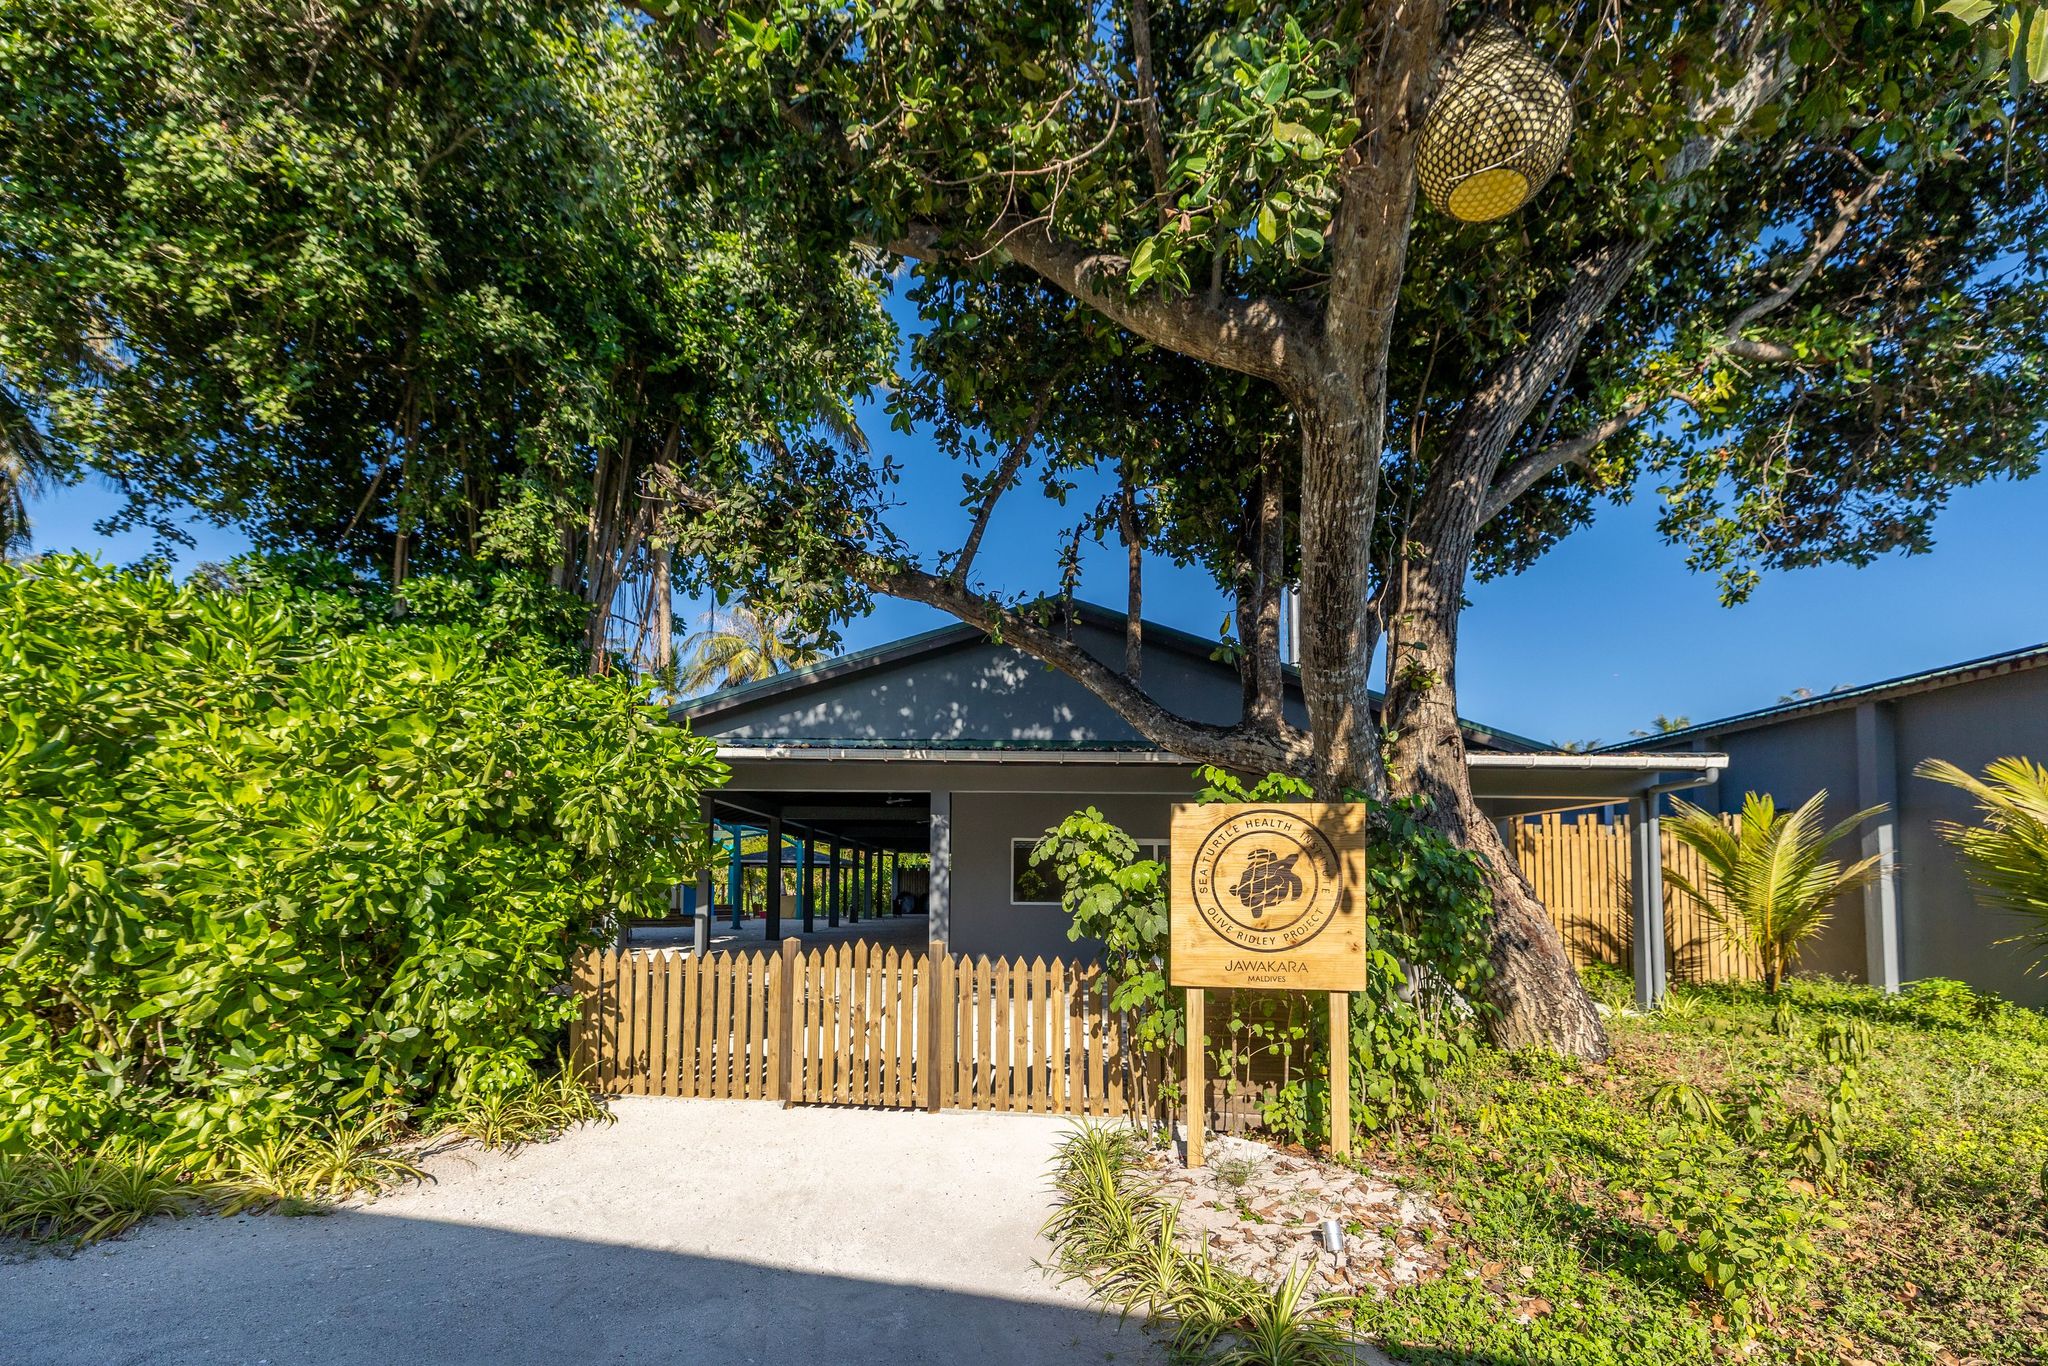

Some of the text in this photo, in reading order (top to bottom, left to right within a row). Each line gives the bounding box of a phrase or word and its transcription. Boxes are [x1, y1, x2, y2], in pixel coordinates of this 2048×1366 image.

[1199, 818, 1331, 894] SEA TURTLE HEALTH INSTITUTE
[1207, 907, 1324, 945] OLIVE RIDLEY PROJECT
[1225, 960, 1308, 973] JAWAKARA
[1247, 975, 1286, 983] MALDIVES
